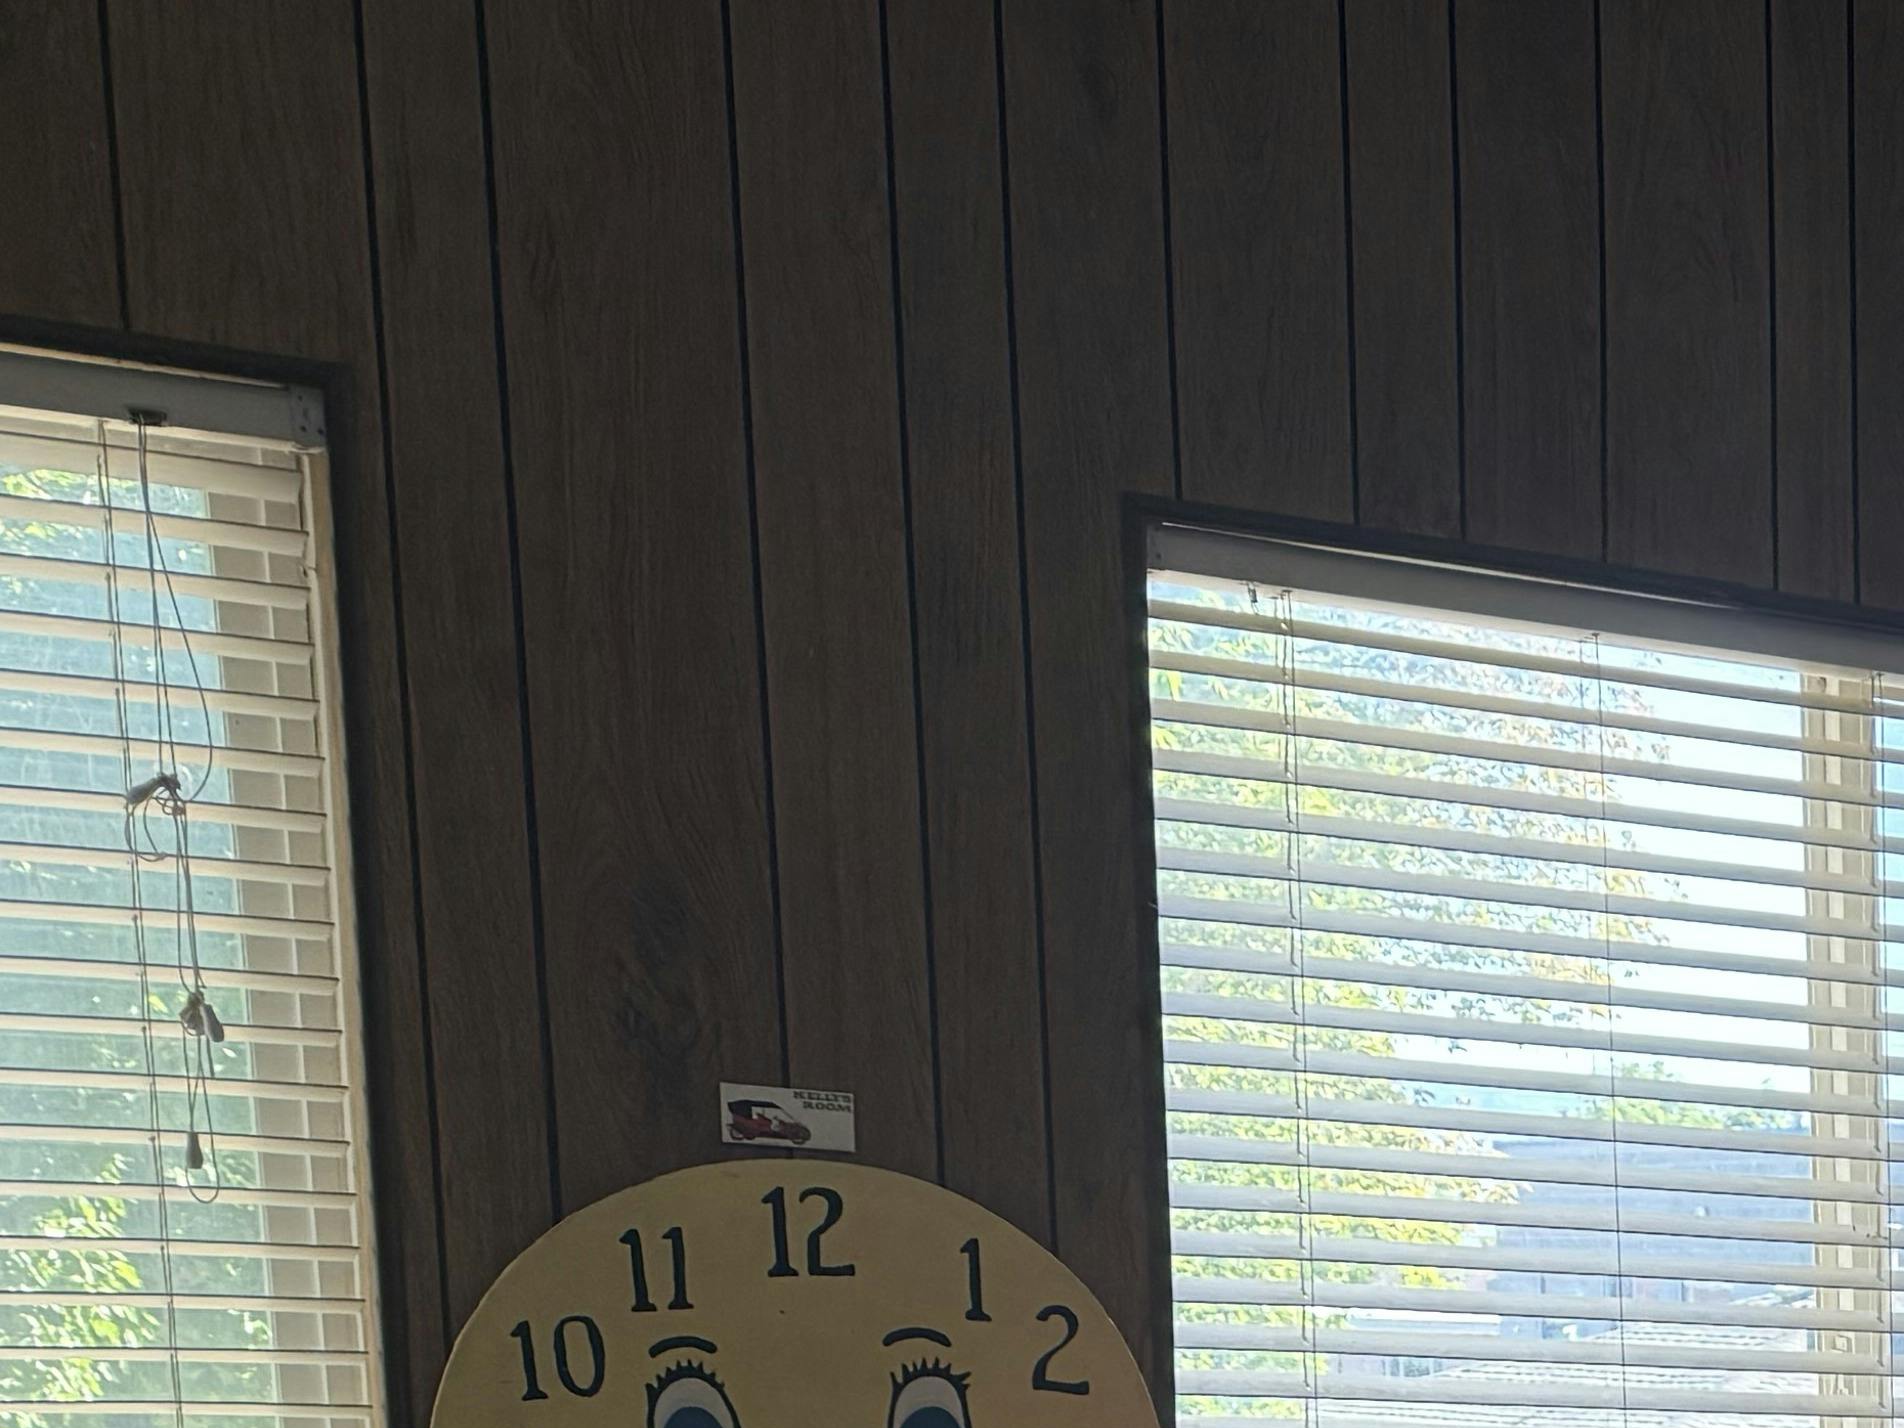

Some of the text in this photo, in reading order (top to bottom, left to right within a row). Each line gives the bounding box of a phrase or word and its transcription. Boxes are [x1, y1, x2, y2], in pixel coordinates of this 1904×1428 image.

[803, 1100, 852, 1113] ROOM
[619, 1226, 694, 1312] 11
[761, 1186, 856, 1277] 12
[959, 1238, 993, 1321] 1
[510, 1315, 606, 1401] 10
[1032, 1304, 1090, 1395] 2
